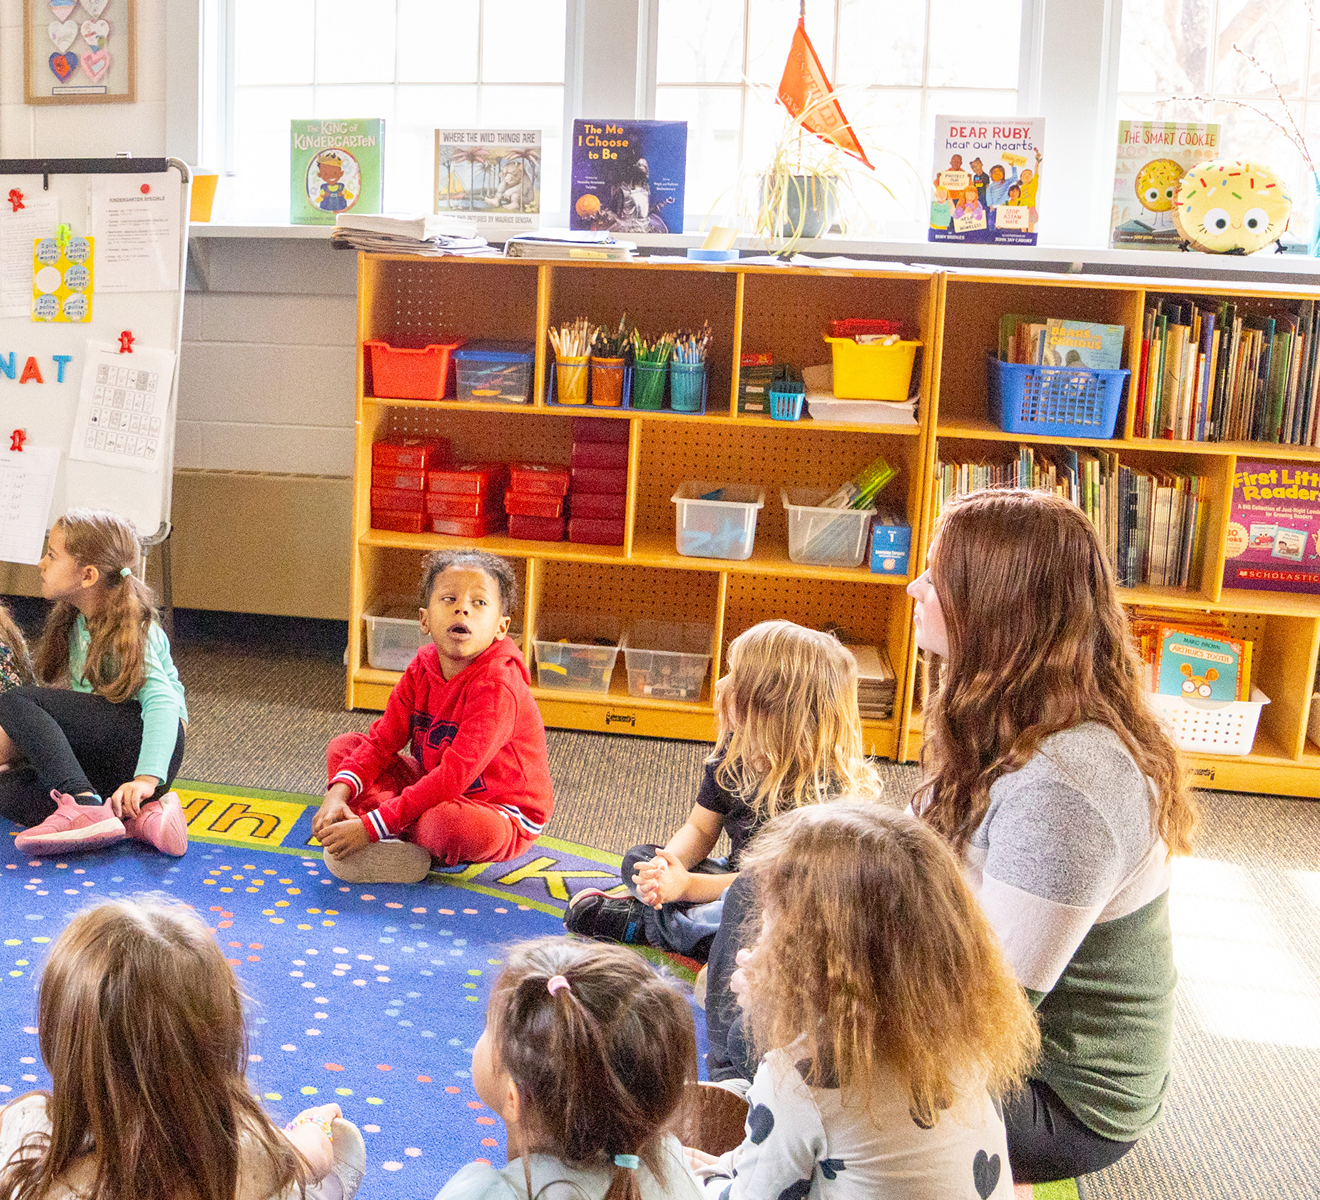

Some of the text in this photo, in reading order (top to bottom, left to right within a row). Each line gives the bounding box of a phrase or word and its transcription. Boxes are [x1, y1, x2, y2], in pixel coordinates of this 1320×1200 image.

[584, 125, 624, 134] The Me
[950, 127, 987, 138] DEAR
[443, 132, 535, 143] WHERE THE WILD THINGS ARE
[578, 136, 629, 147] I Choose
[1124, 130, 1216, 146] THE SMART COOKIE
[946, 139, 1033, 150] hear our hearts
[588, 148, 617, 159] to Be
[1051, 327, 1091, 339] BEARS
[1050, 336, 1102, 350] CURIOUS
[1233, 470, 1278, 488] First
[1249, 571, 1320, 582] SCHOLASTIC
[1183, 638, 1220, 650] MARC BROWN
[1172, 645, 1230, 663] ARTHUR'S TOOTH
